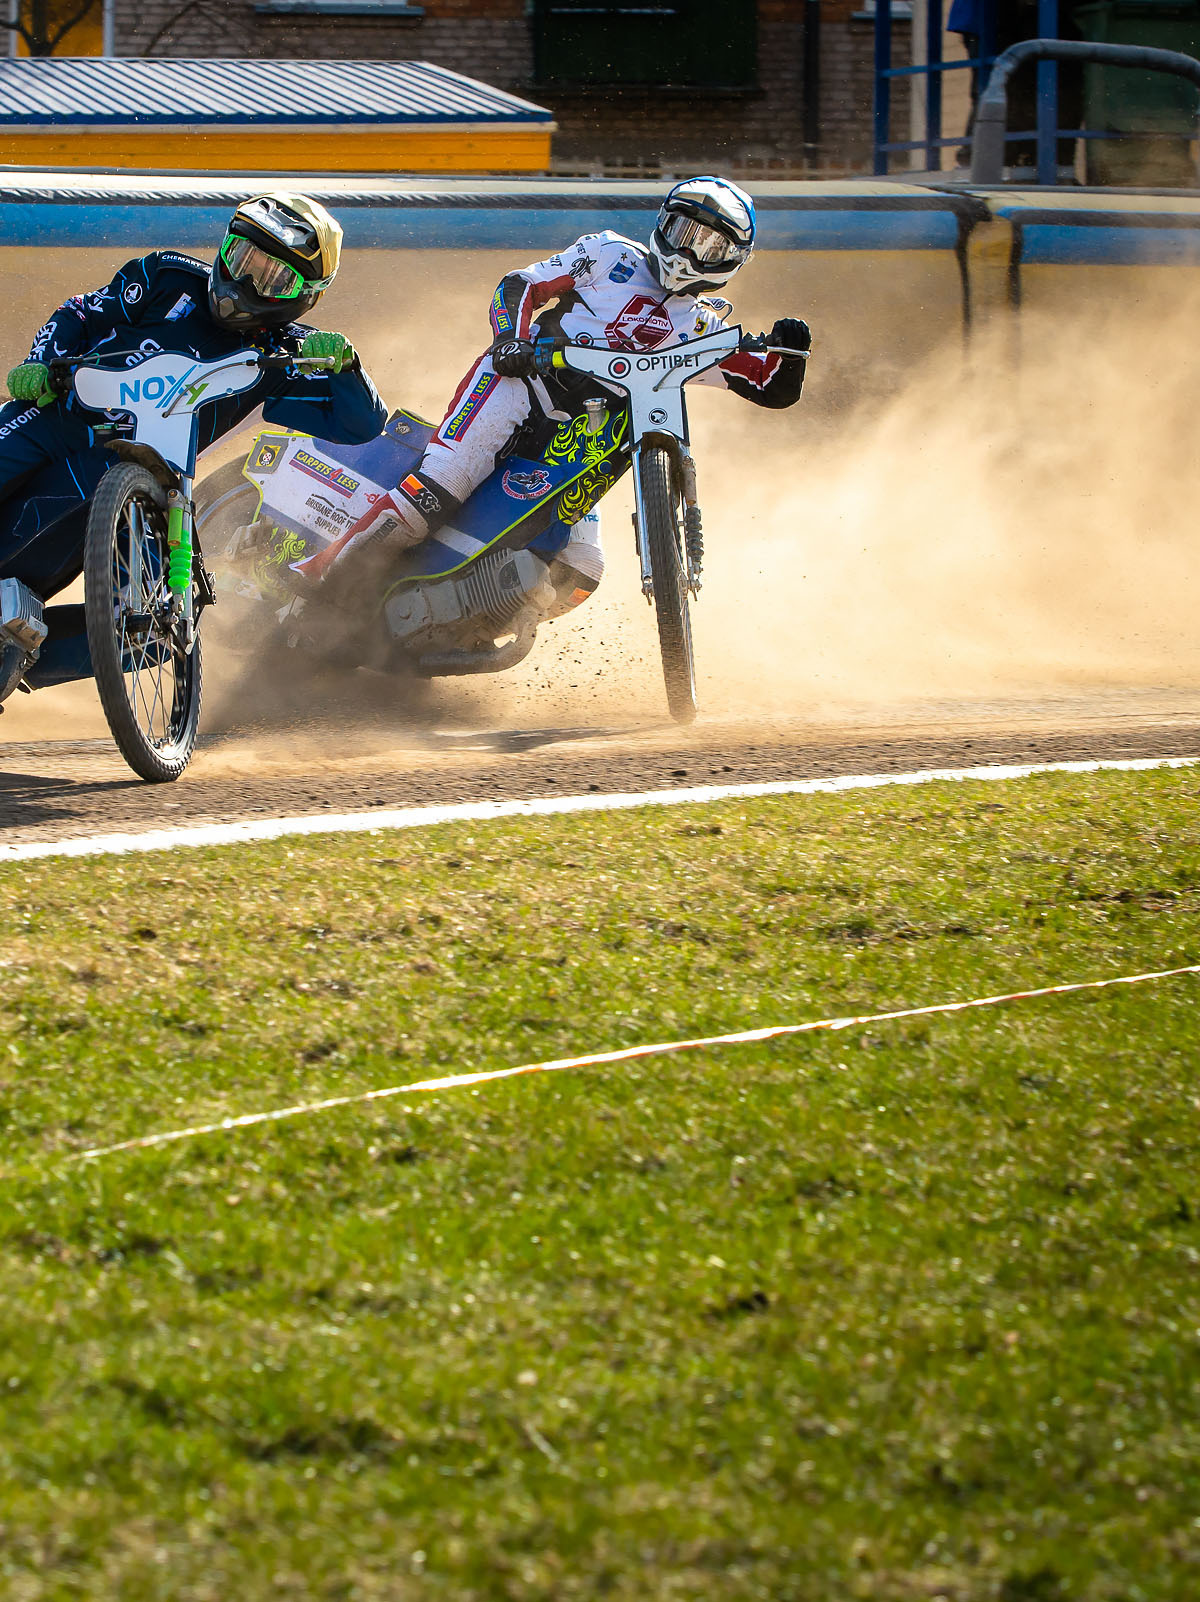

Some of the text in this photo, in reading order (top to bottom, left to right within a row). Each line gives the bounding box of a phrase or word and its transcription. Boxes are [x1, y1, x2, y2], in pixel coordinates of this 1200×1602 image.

[161, 254, 202, 270] CHEMART
[497, 315, 510, 330] LESS
[636, 353, 700, 371] OPTIBET
[447, 375, 491, 436] CARPETS 4 LESS
[296, 451, 333, 476] CARPETS
[329, 467, 344, 481] 4
[336, 474, 358, 490] LESS
[305, 497, 333, 518] BRISBANE
[330, 511, 347, 525] ROOF
[314, 516, 342, 537] SUPPLIES
